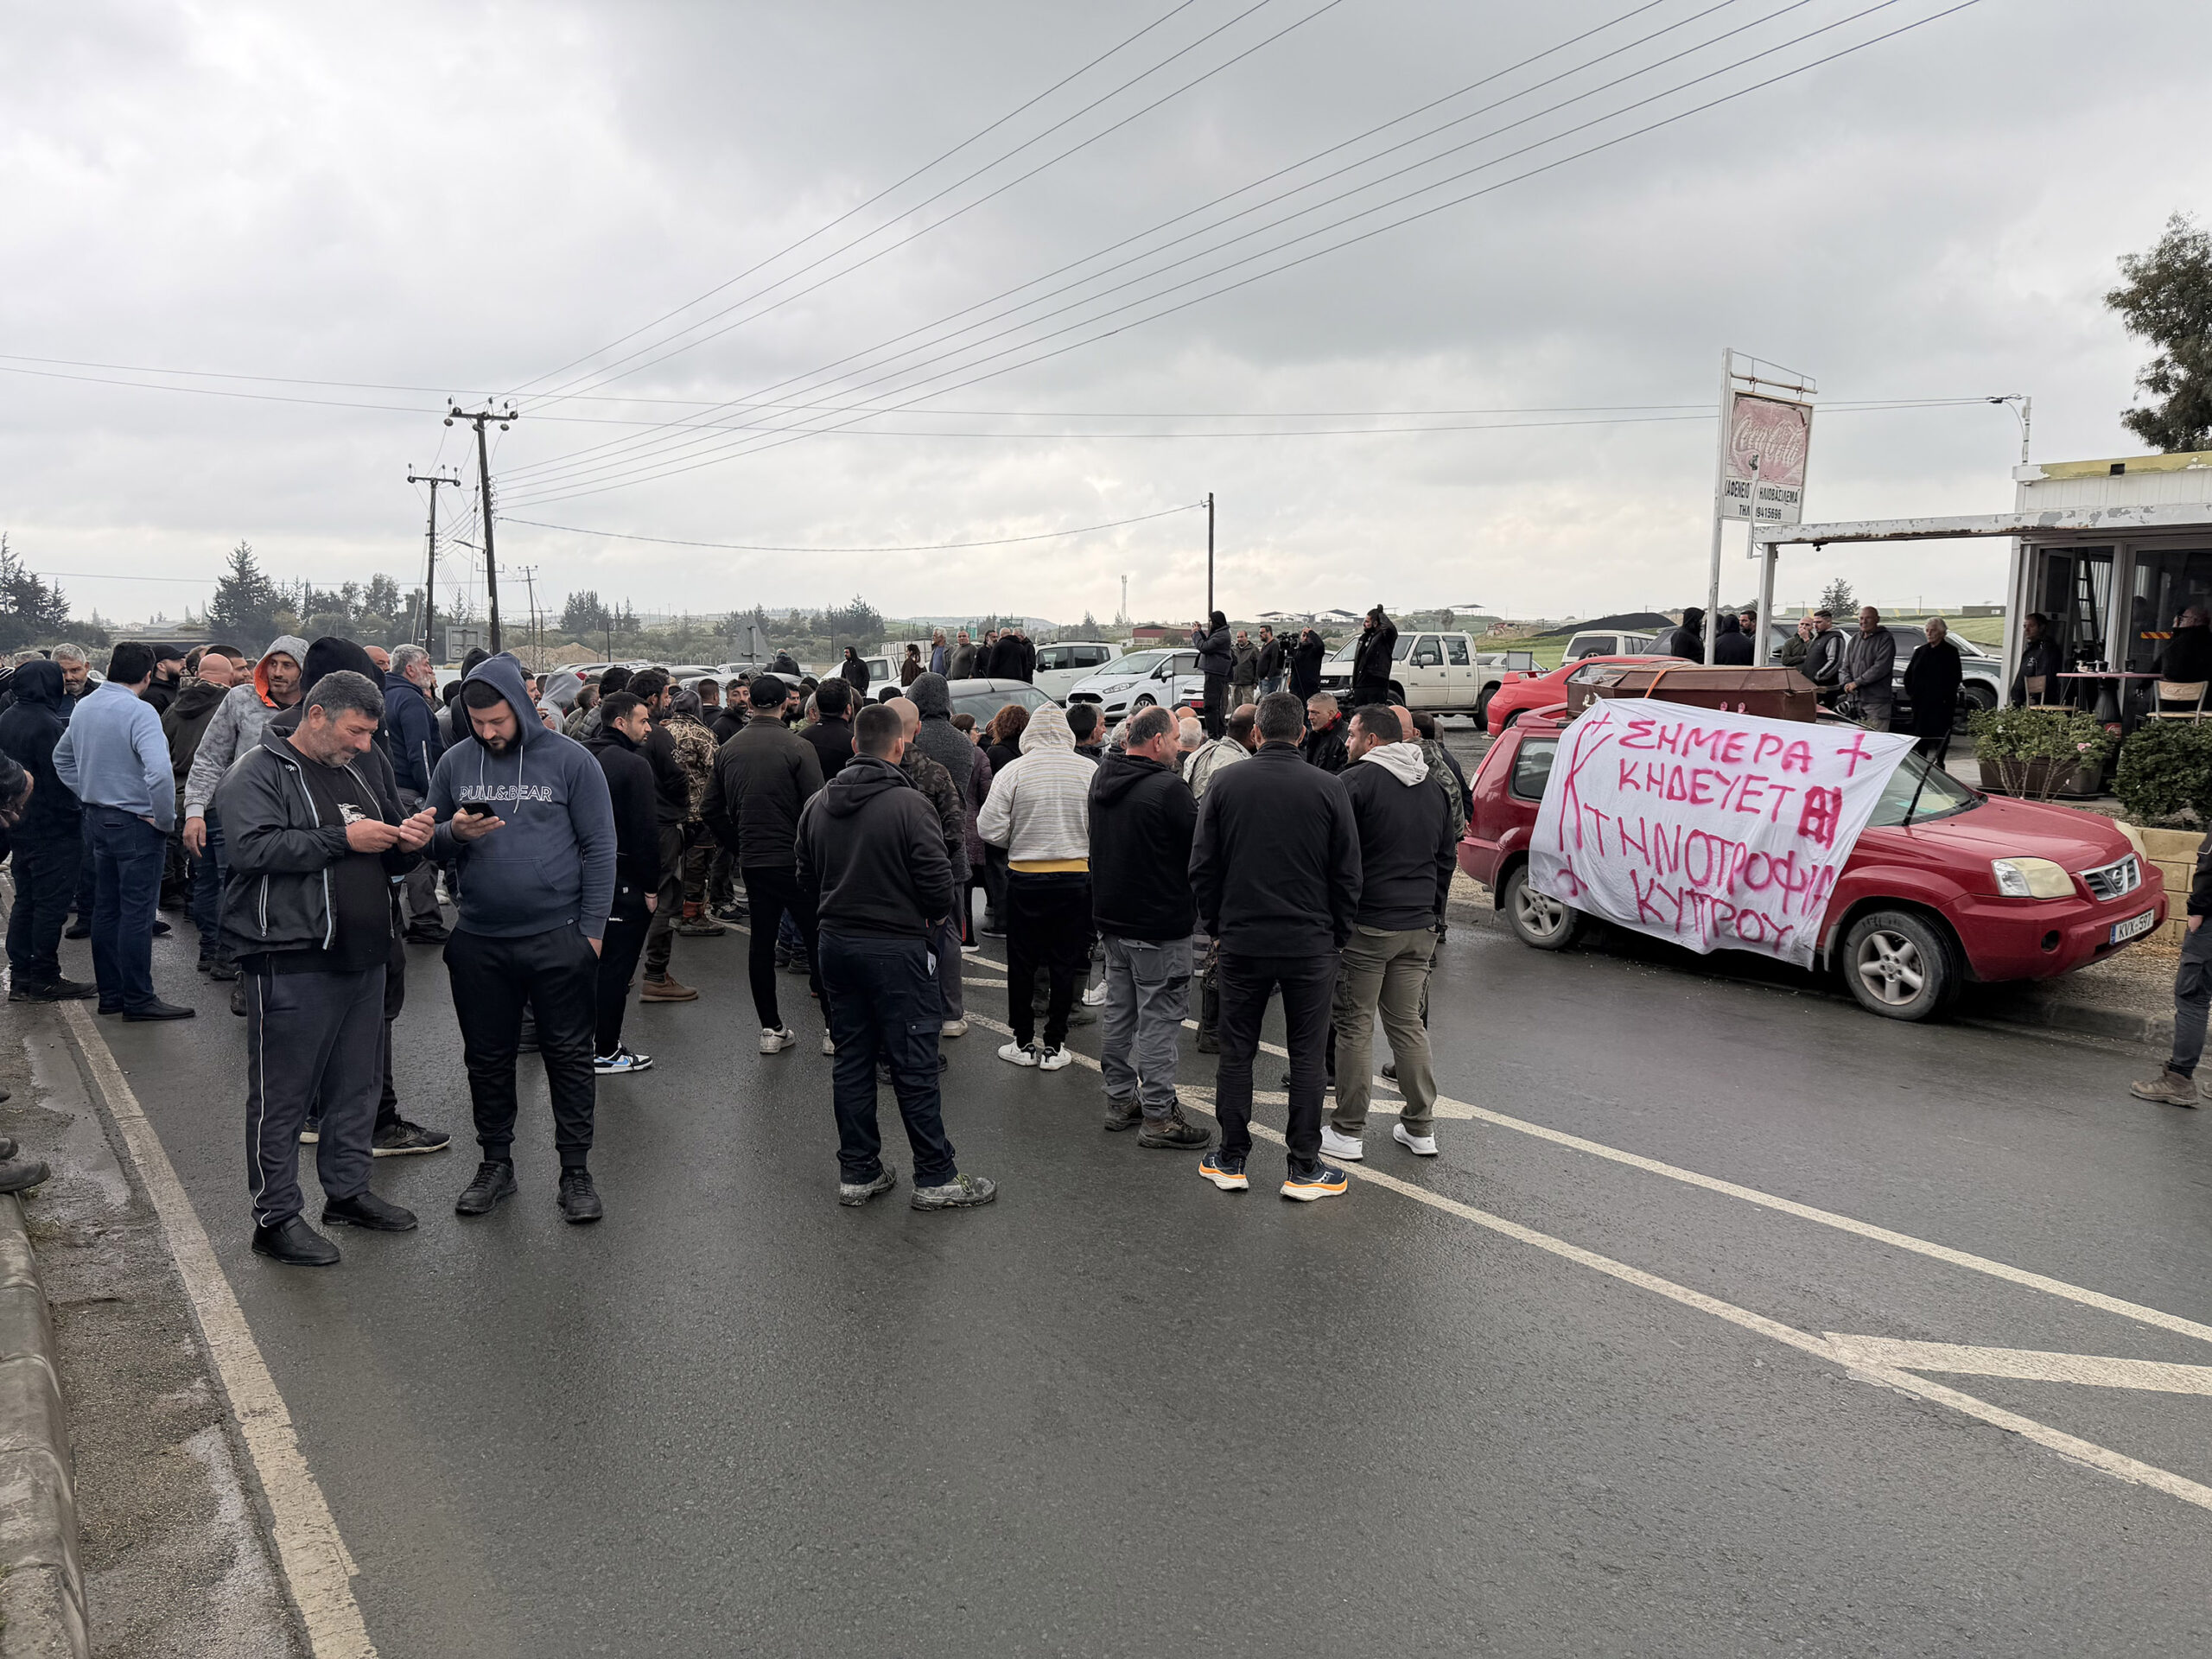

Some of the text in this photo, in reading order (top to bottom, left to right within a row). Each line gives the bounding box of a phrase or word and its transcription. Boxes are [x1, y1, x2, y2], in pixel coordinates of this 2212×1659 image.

[1618, 720, 1814, 773] ΣΗΜΕΡΑ
[460, 785, 552, 802] PULL&BEAR
[1630, 868, 1794, 953] ΚΥΠΡΟΥ
[2119, 921, 2135, 938] KVX
